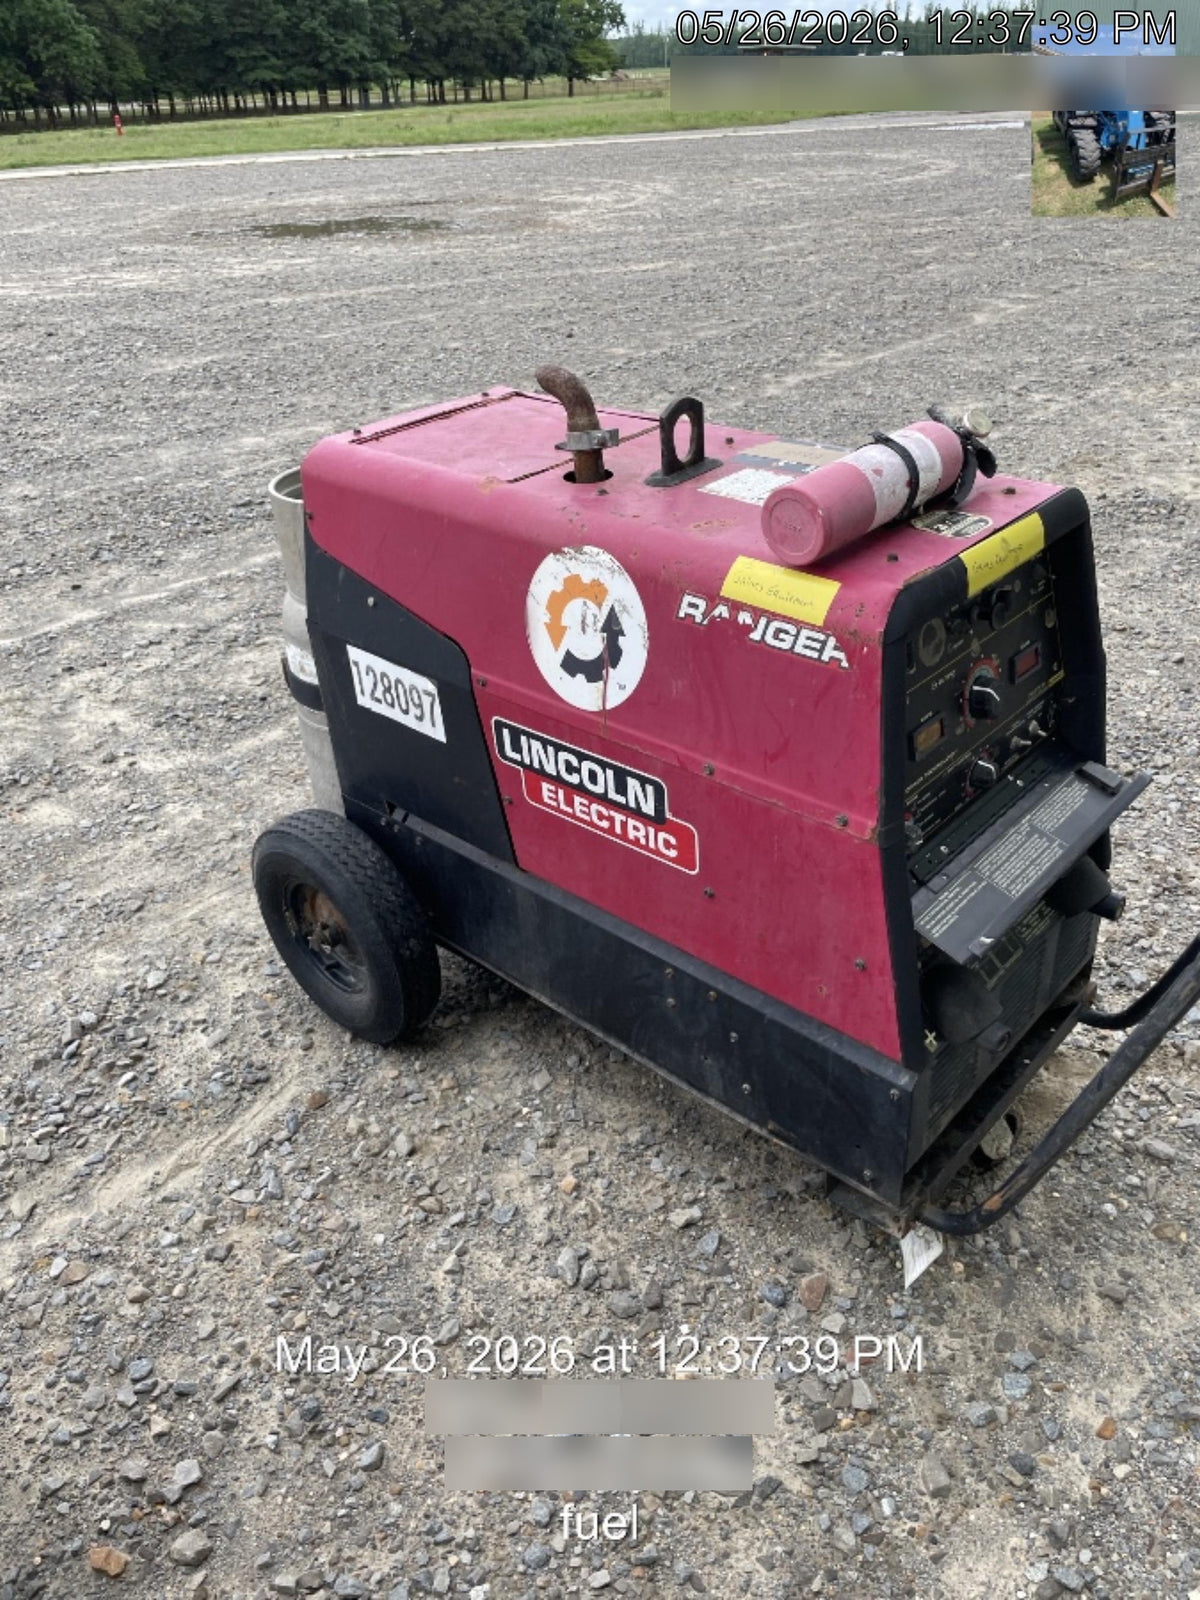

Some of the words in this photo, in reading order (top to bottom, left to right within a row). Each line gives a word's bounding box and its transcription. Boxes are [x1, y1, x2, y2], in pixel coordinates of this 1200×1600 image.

[351, 659, 437, 729] 128097
[502, 727, 656, 818] LINCOLN
[540, 781, 679, 859] ELECTRIC
